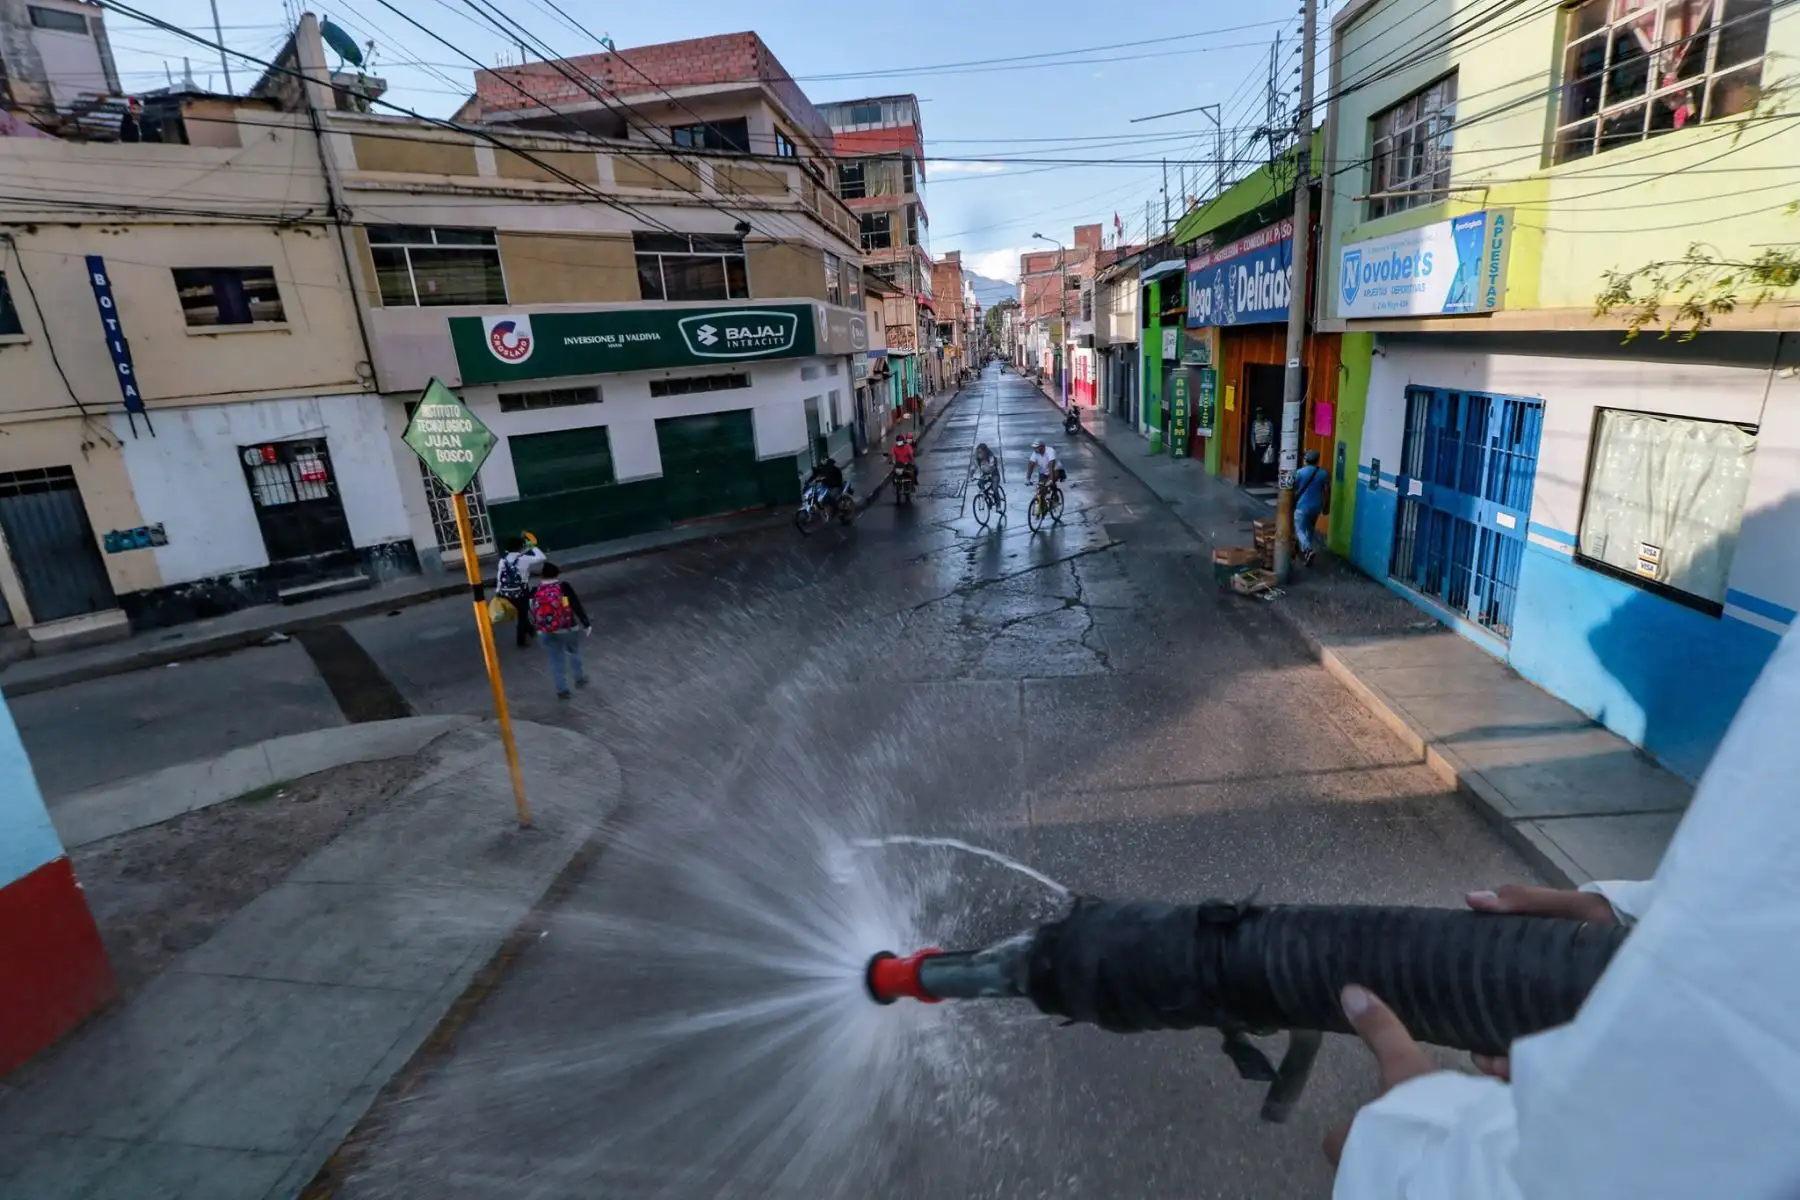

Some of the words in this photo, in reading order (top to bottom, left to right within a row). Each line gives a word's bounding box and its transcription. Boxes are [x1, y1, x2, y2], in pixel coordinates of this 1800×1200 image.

[1243, 233, 1265, 251] COMIDA
[1485, 214, 1505, 308] APUESTAS
[1188, 279, 1212, 323] Mega
[1237, 257, 1293, 312] Delicias
[93, 273, 137, 397] BOTICA
[564, 335, 615, 345] INVERSIONES
[625, 333, 661, 342] VALDIVIA
[725, 324, 785, 340] BAJAJ
[492, 333, 528, 358] CROSLAND
[727, 337, 785, 348] INTRACITY
[1174, 378, 1186, 456] ACADEMIA
[424, 434, 463, 448] JUAN
[435, 449, 474, 462] BOSCO
[1643, 546, 1657, 557] VISA
[1640, 563, 1654, 572] VISA
